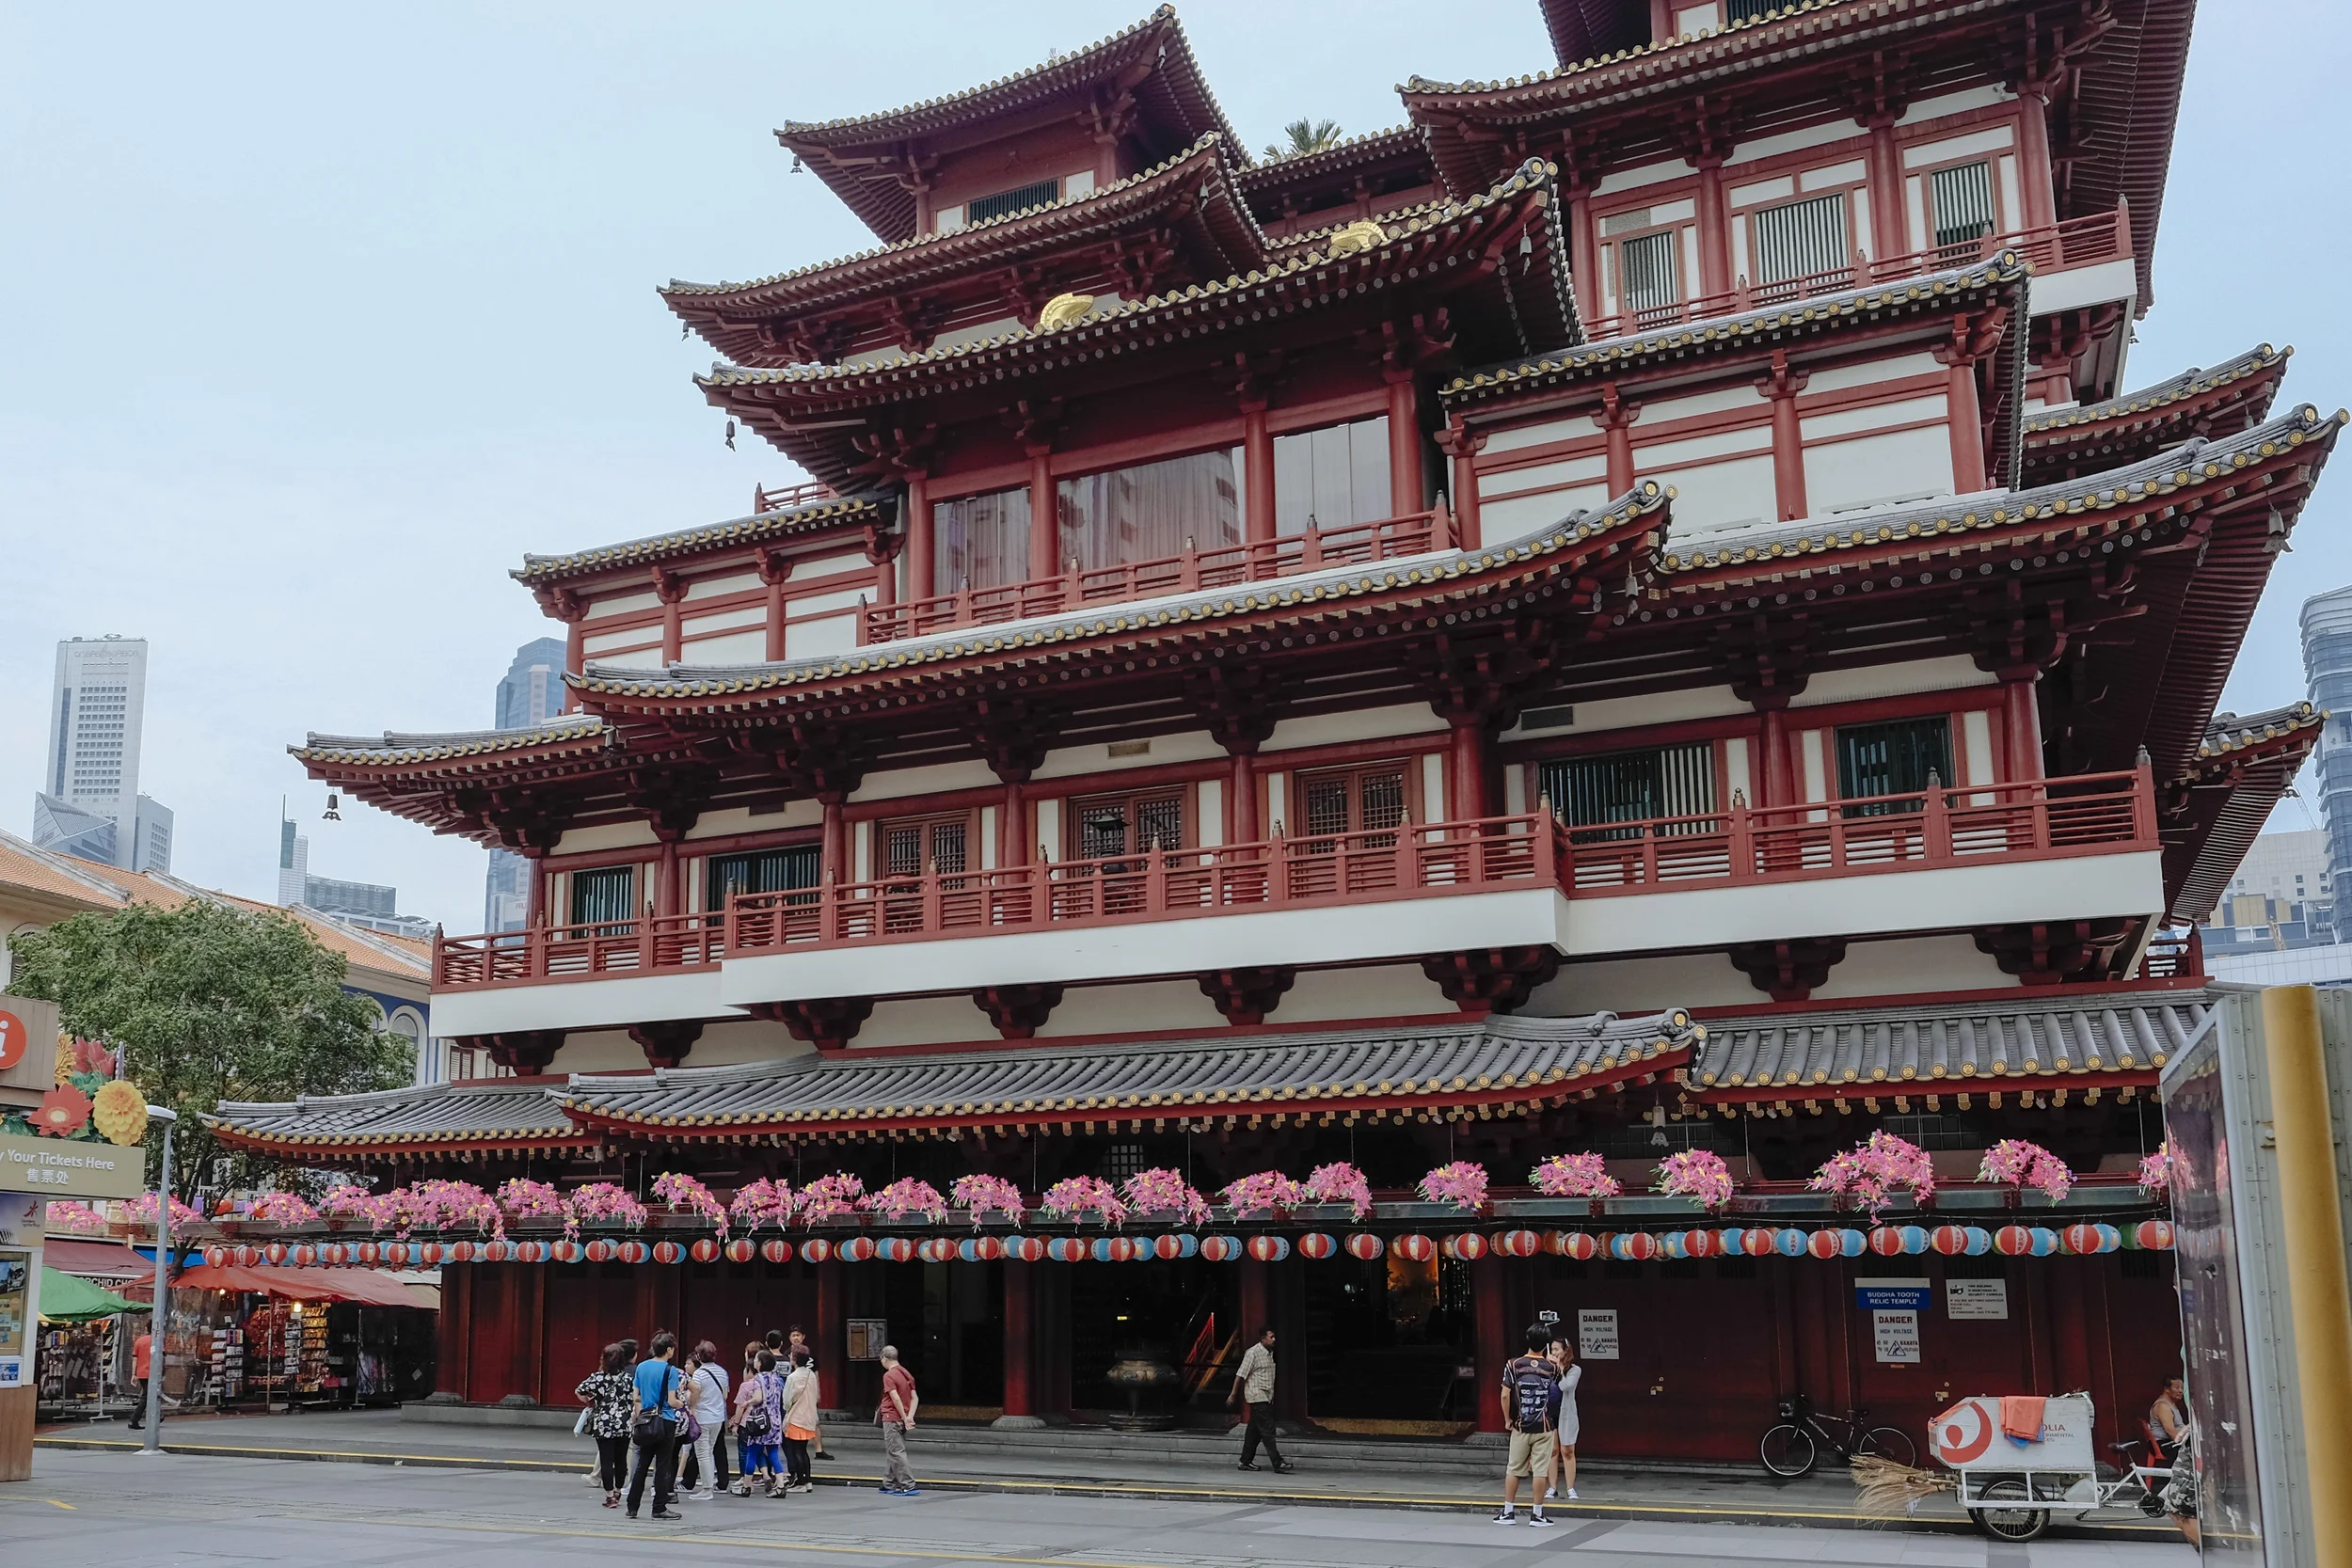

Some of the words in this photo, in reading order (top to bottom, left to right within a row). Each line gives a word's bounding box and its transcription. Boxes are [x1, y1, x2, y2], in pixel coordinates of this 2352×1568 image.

[8, 1148, 36, 1164] Your
[38, 1151, 83, 1167] Tickets
[86, 1156, 115, 1170] Here
[26, 1167, 69, 1185] 售票处
[79, 1276, 113, 1287] RCHID
